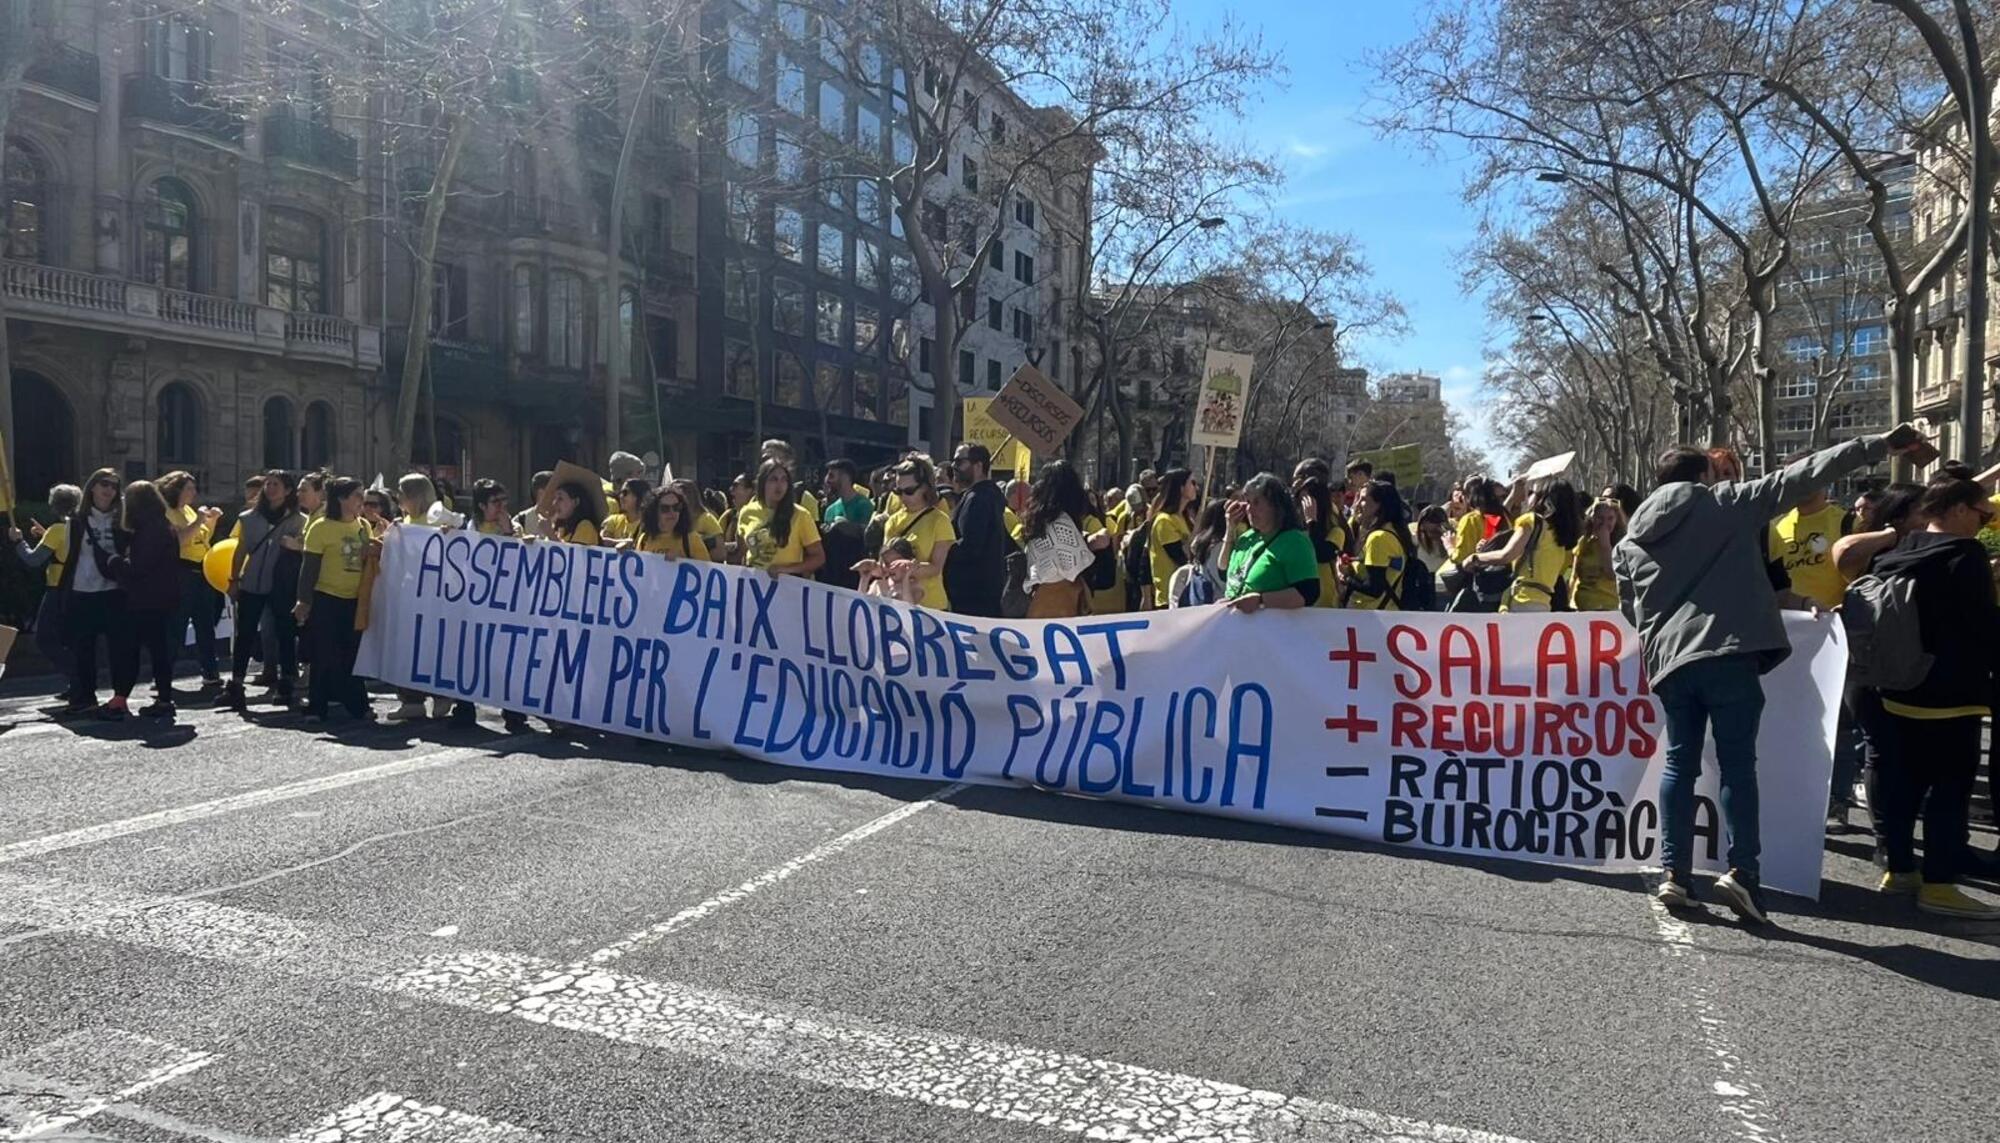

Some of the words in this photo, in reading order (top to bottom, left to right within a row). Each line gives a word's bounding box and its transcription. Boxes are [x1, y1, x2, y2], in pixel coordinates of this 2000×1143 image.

[417, 533, 643, 629] ASSEMBLEES
[664, 563, 778, 649] BAIX
[803, 586, 1149, 691] LLOBREGAT
[411, 614, 590, 719] LLUITEM
[602, 636, 670, 735] PER
[693, 647, 976, 778] L'EDUCACIÓ
[1002, 683, 1273, 809] PÚBLICA
[1391, 700, 1656, 758] RECURSOS
[1390, 751, 1604, 812] RÀTIOS
[1384, 792, 1719, 860] BUROCRÀCA
